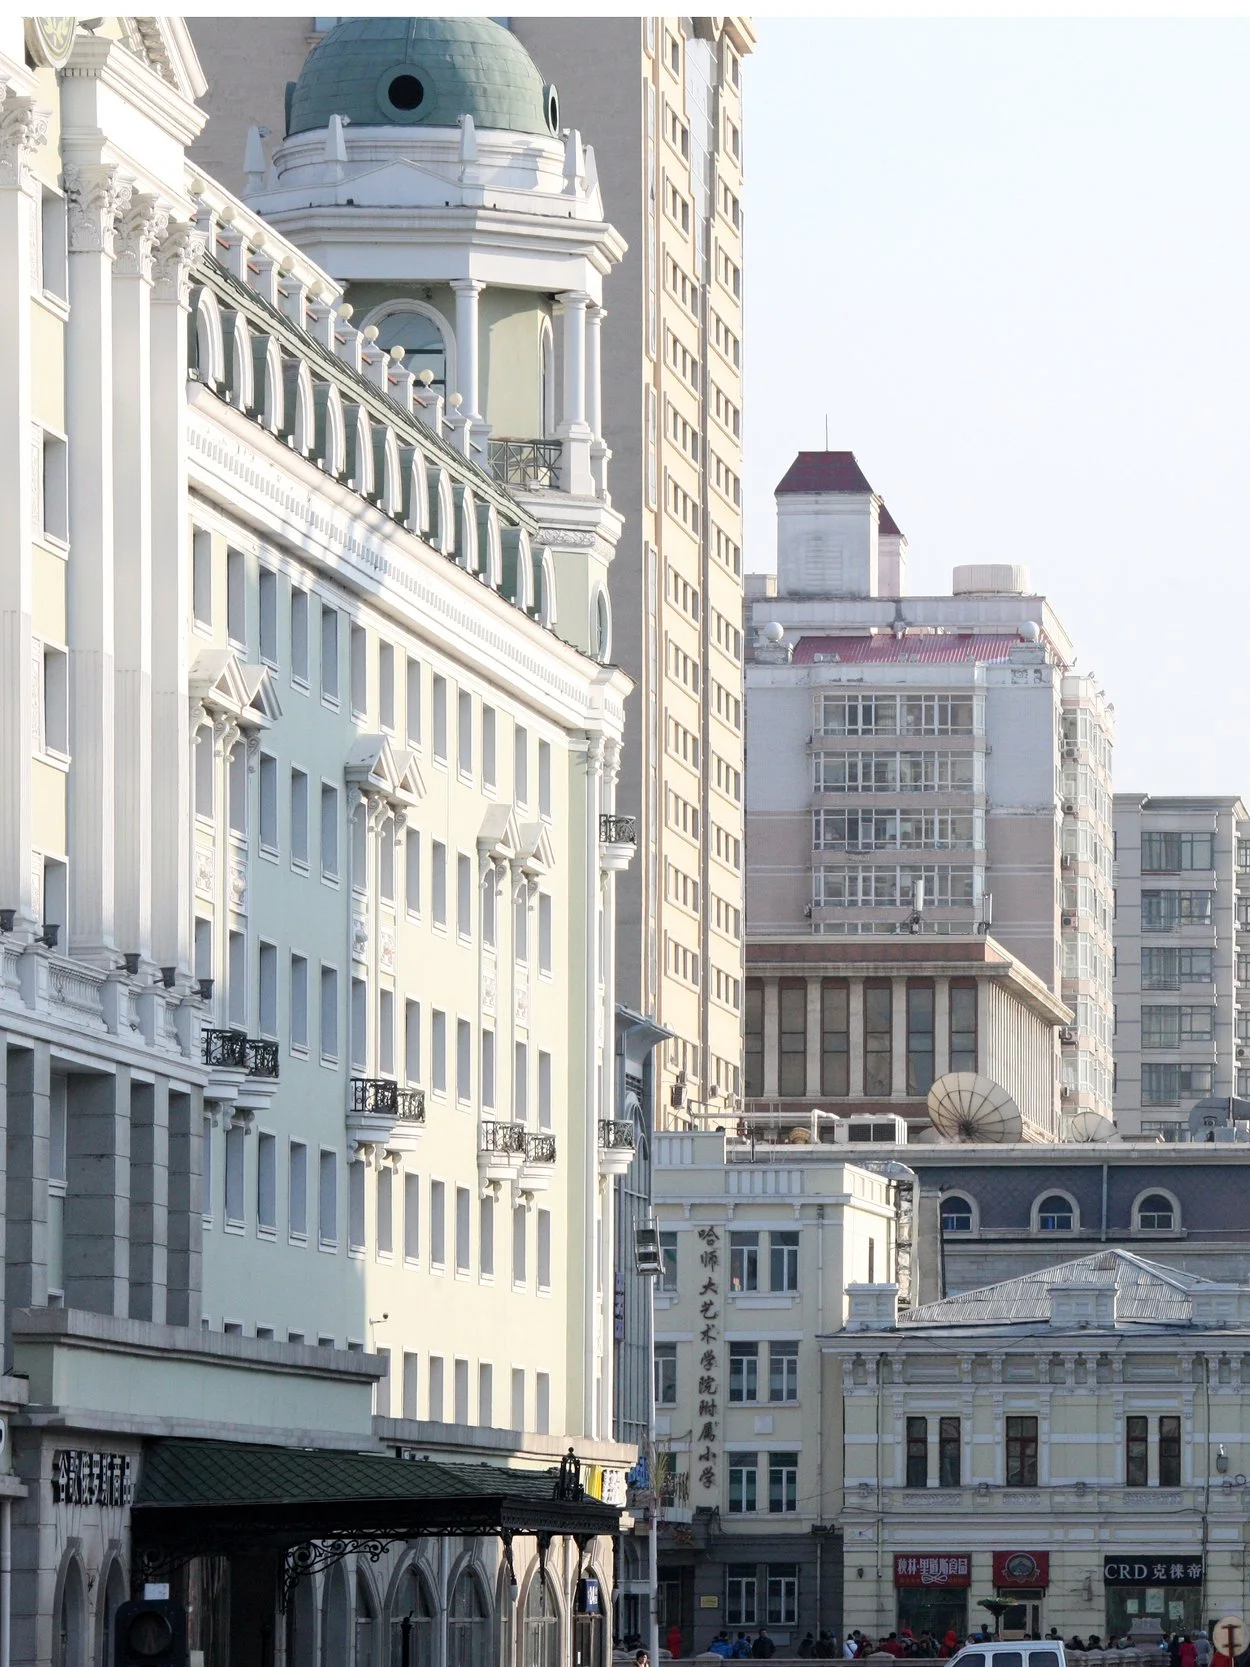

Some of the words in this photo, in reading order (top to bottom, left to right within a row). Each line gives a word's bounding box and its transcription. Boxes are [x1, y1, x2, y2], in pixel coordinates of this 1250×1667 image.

[697, 1225, 720, 1490] 哈师大艺术学院附属小学
[1104, 1563, 1148, 1579] CRD
